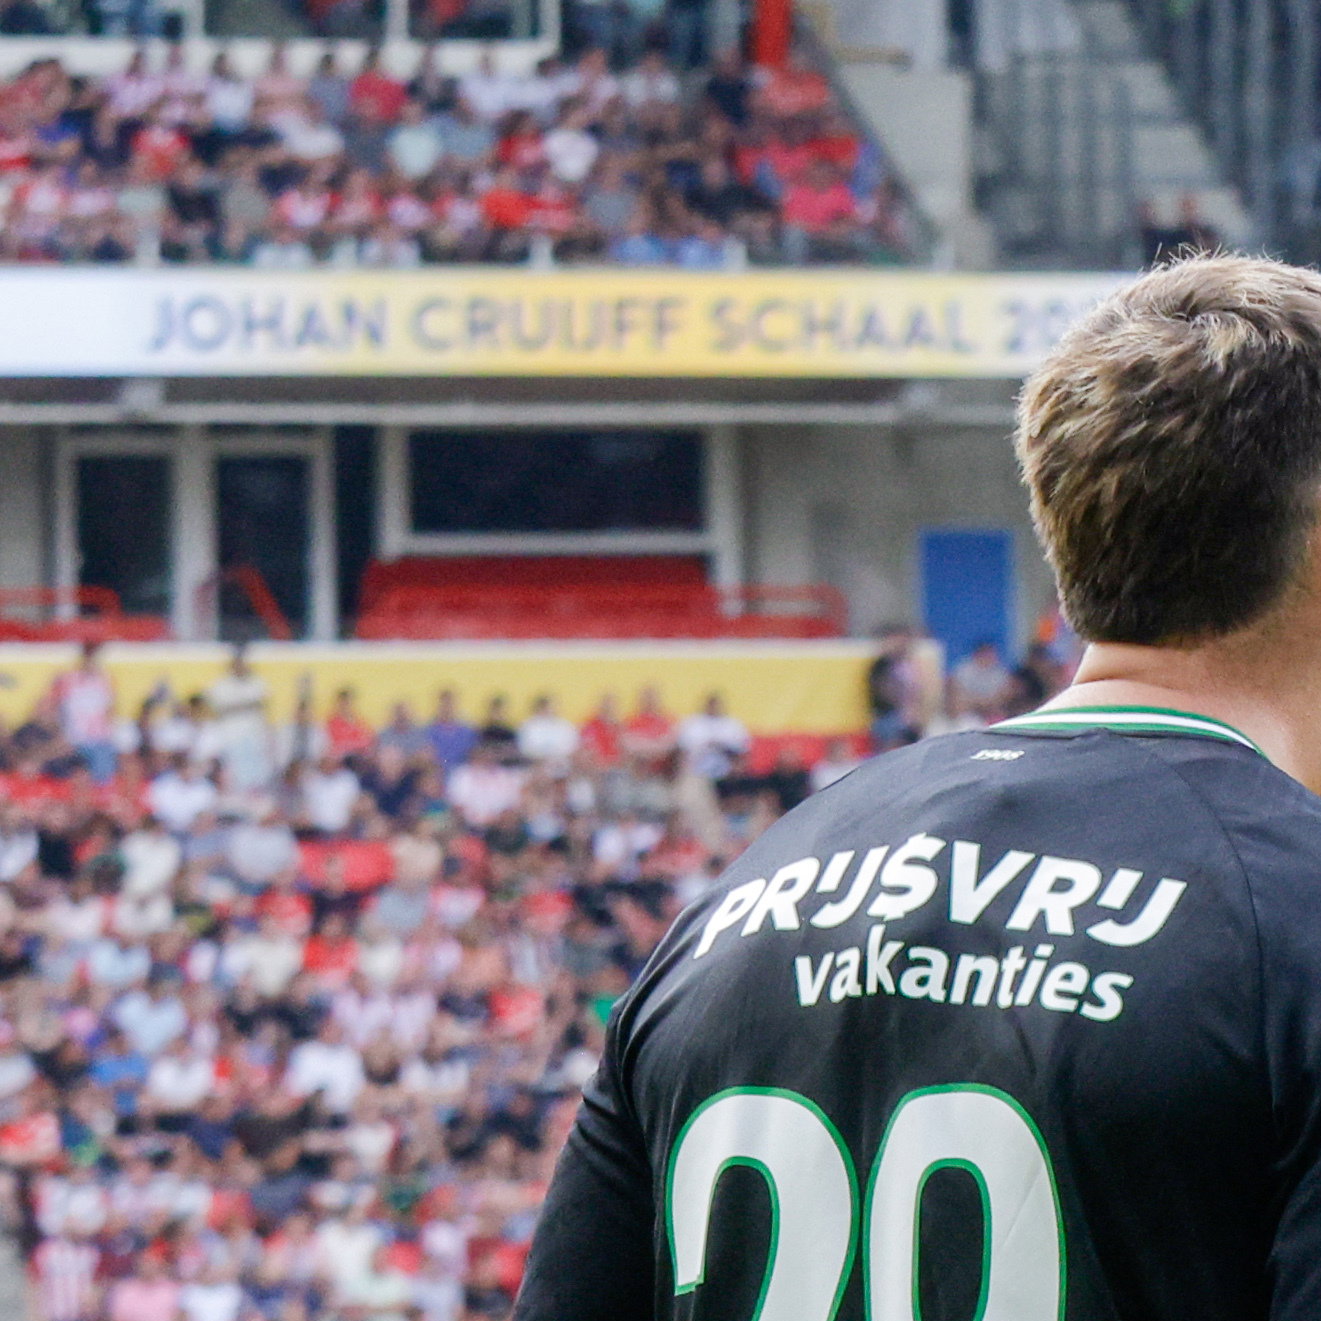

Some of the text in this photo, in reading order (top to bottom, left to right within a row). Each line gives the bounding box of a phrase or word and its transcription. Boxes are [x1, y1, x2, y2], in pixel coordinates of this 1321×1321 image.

[147, 294, 388, 353] JOHAN
[410, 293, 688, 354] CRUIJFF
[708, 295, 975, 354] SCHAAL
[793, 923, 1134, 1022] vakanties
